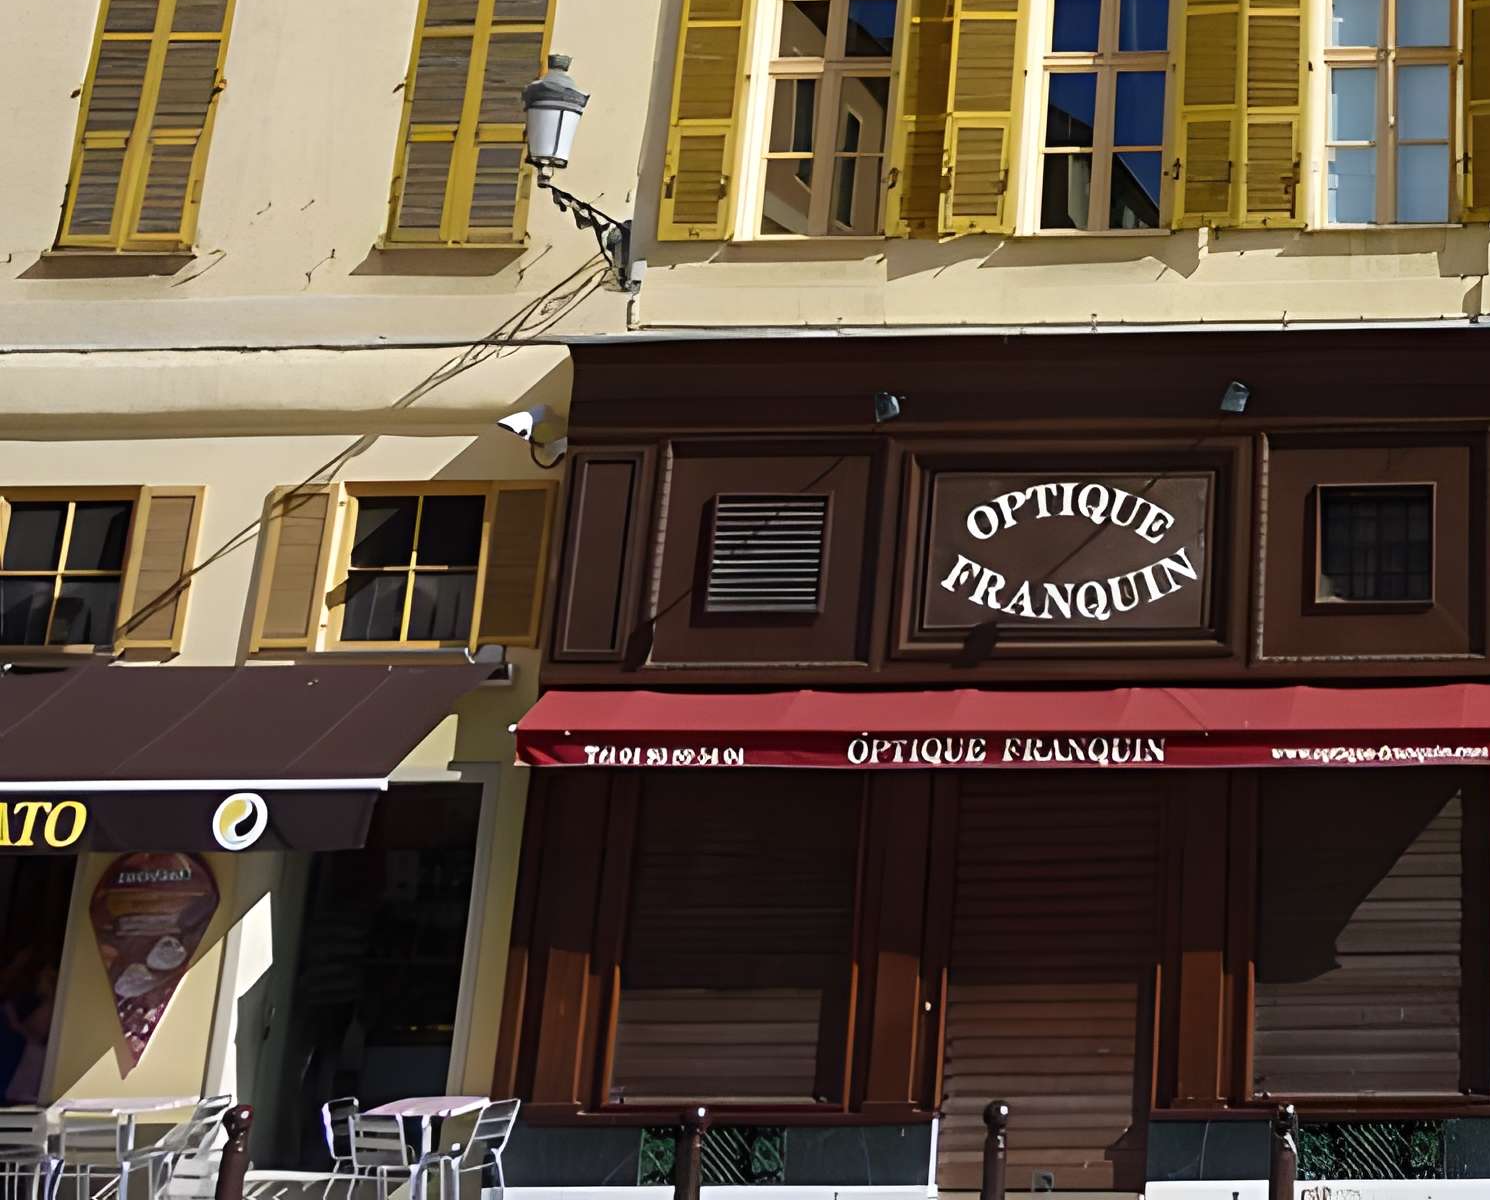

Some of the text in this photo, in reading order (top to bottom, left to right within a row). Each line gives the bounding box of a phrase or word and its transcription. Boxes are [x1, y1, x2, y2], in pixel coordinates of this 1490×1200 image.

[966, 482, 1175, 544] OPTIQUE
[940, 547, 1198, 621] FRANQUIN
[847, 737, 987, 764] OPTIQUE
[1001, 737, 1166, 765] FRANQUIN
